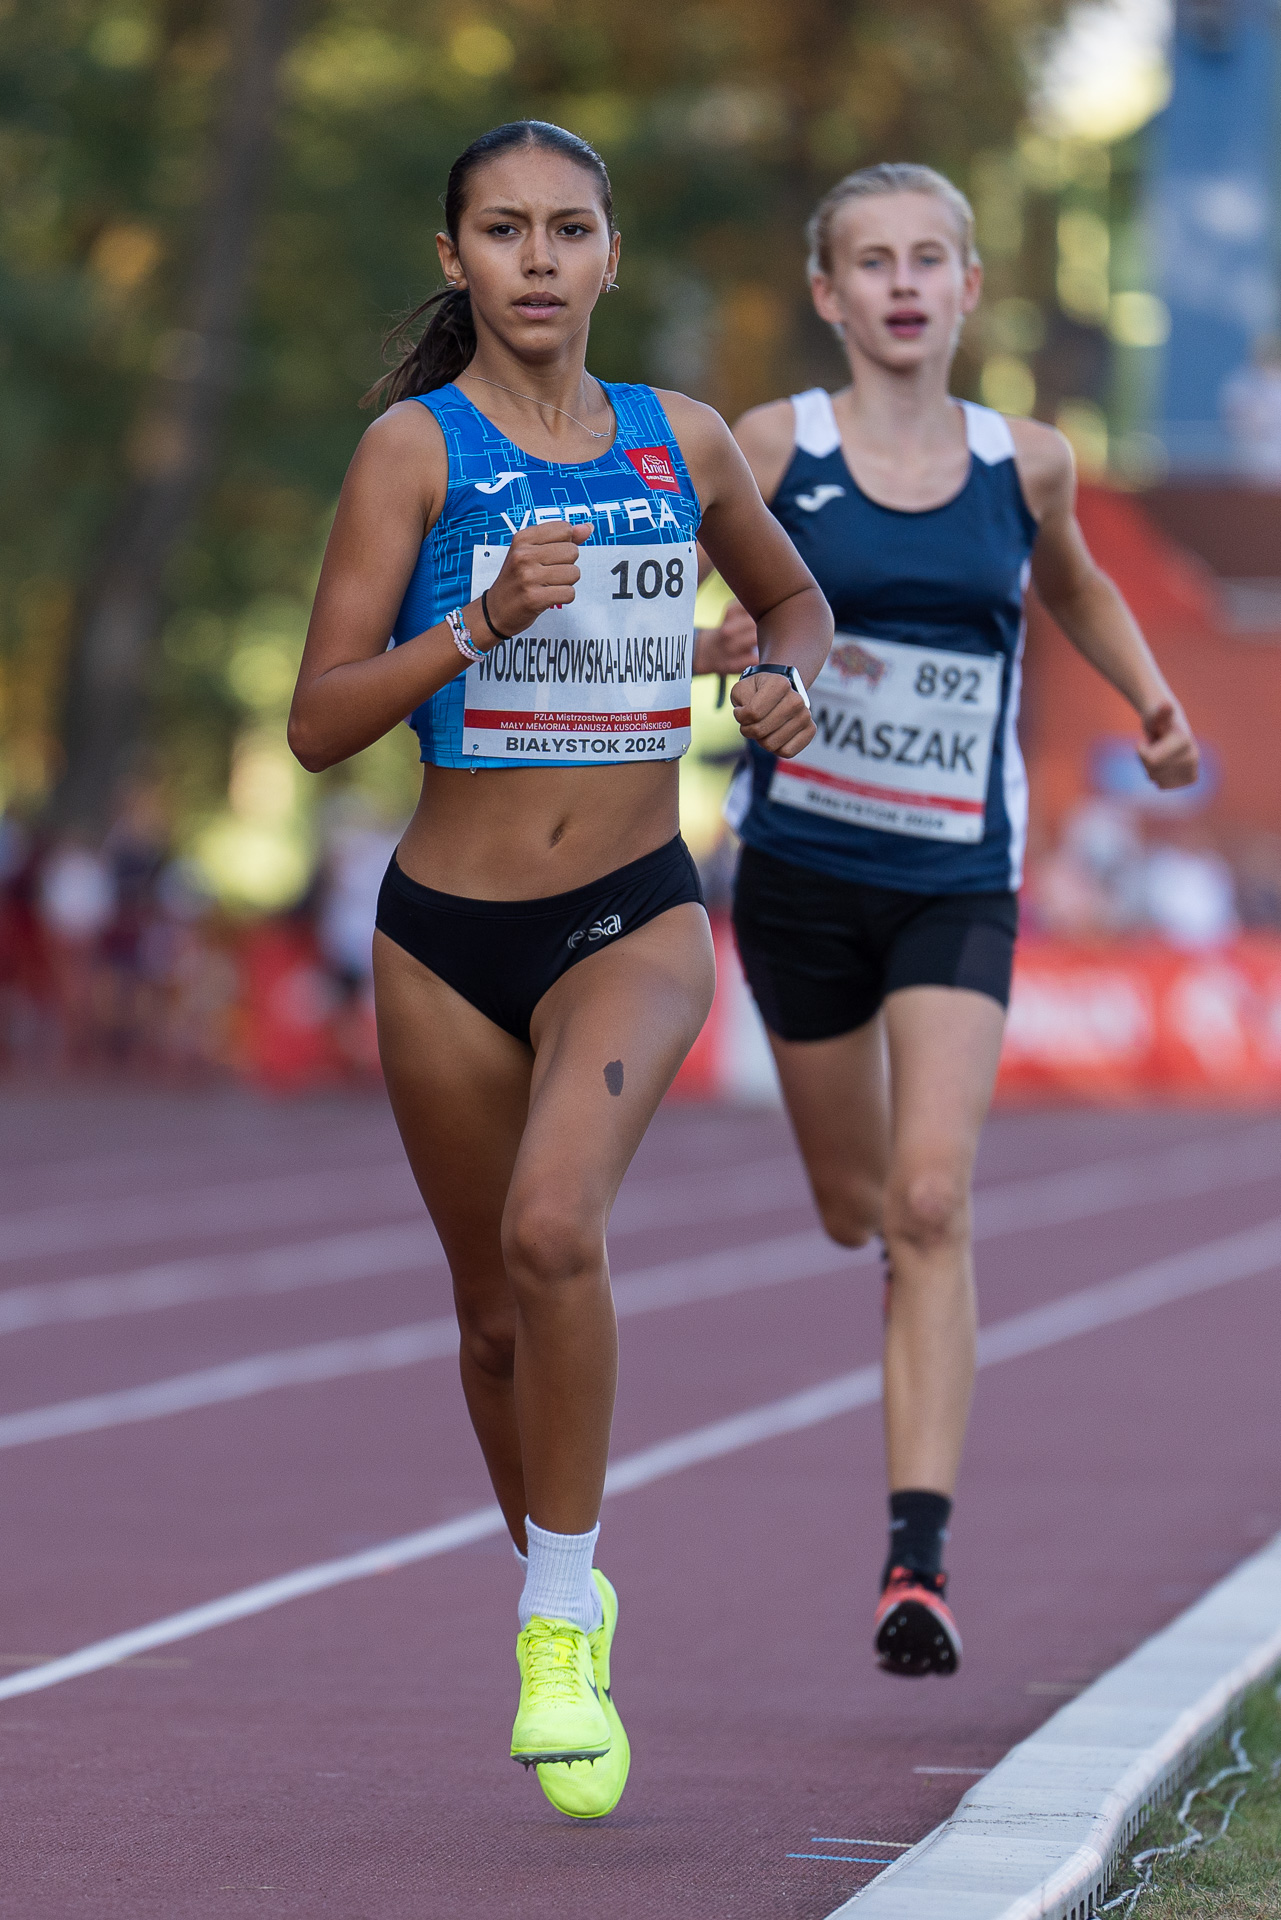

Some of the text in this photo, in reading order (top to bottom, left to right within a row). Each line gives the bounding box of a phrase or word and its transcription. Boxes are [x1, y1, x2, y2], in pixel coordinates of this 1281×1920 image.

[641, 457, 671, 475] Anwil
[610, 557, 684, 600] 108
[479, 633, 688, 683] WOJCIECHOWSKA-LAMSALLAK
[914, 660, 982, 703] 892
[500, 721, 672, 732] MAŁY MEMORIAŁ JANUSZA KUSOCIŃSKIEGO
[533, 712, 648, 723] PZLA Mistrzostwa Polski U16
[506, 736, 666, 754] BIAŁYSTOK 2024
